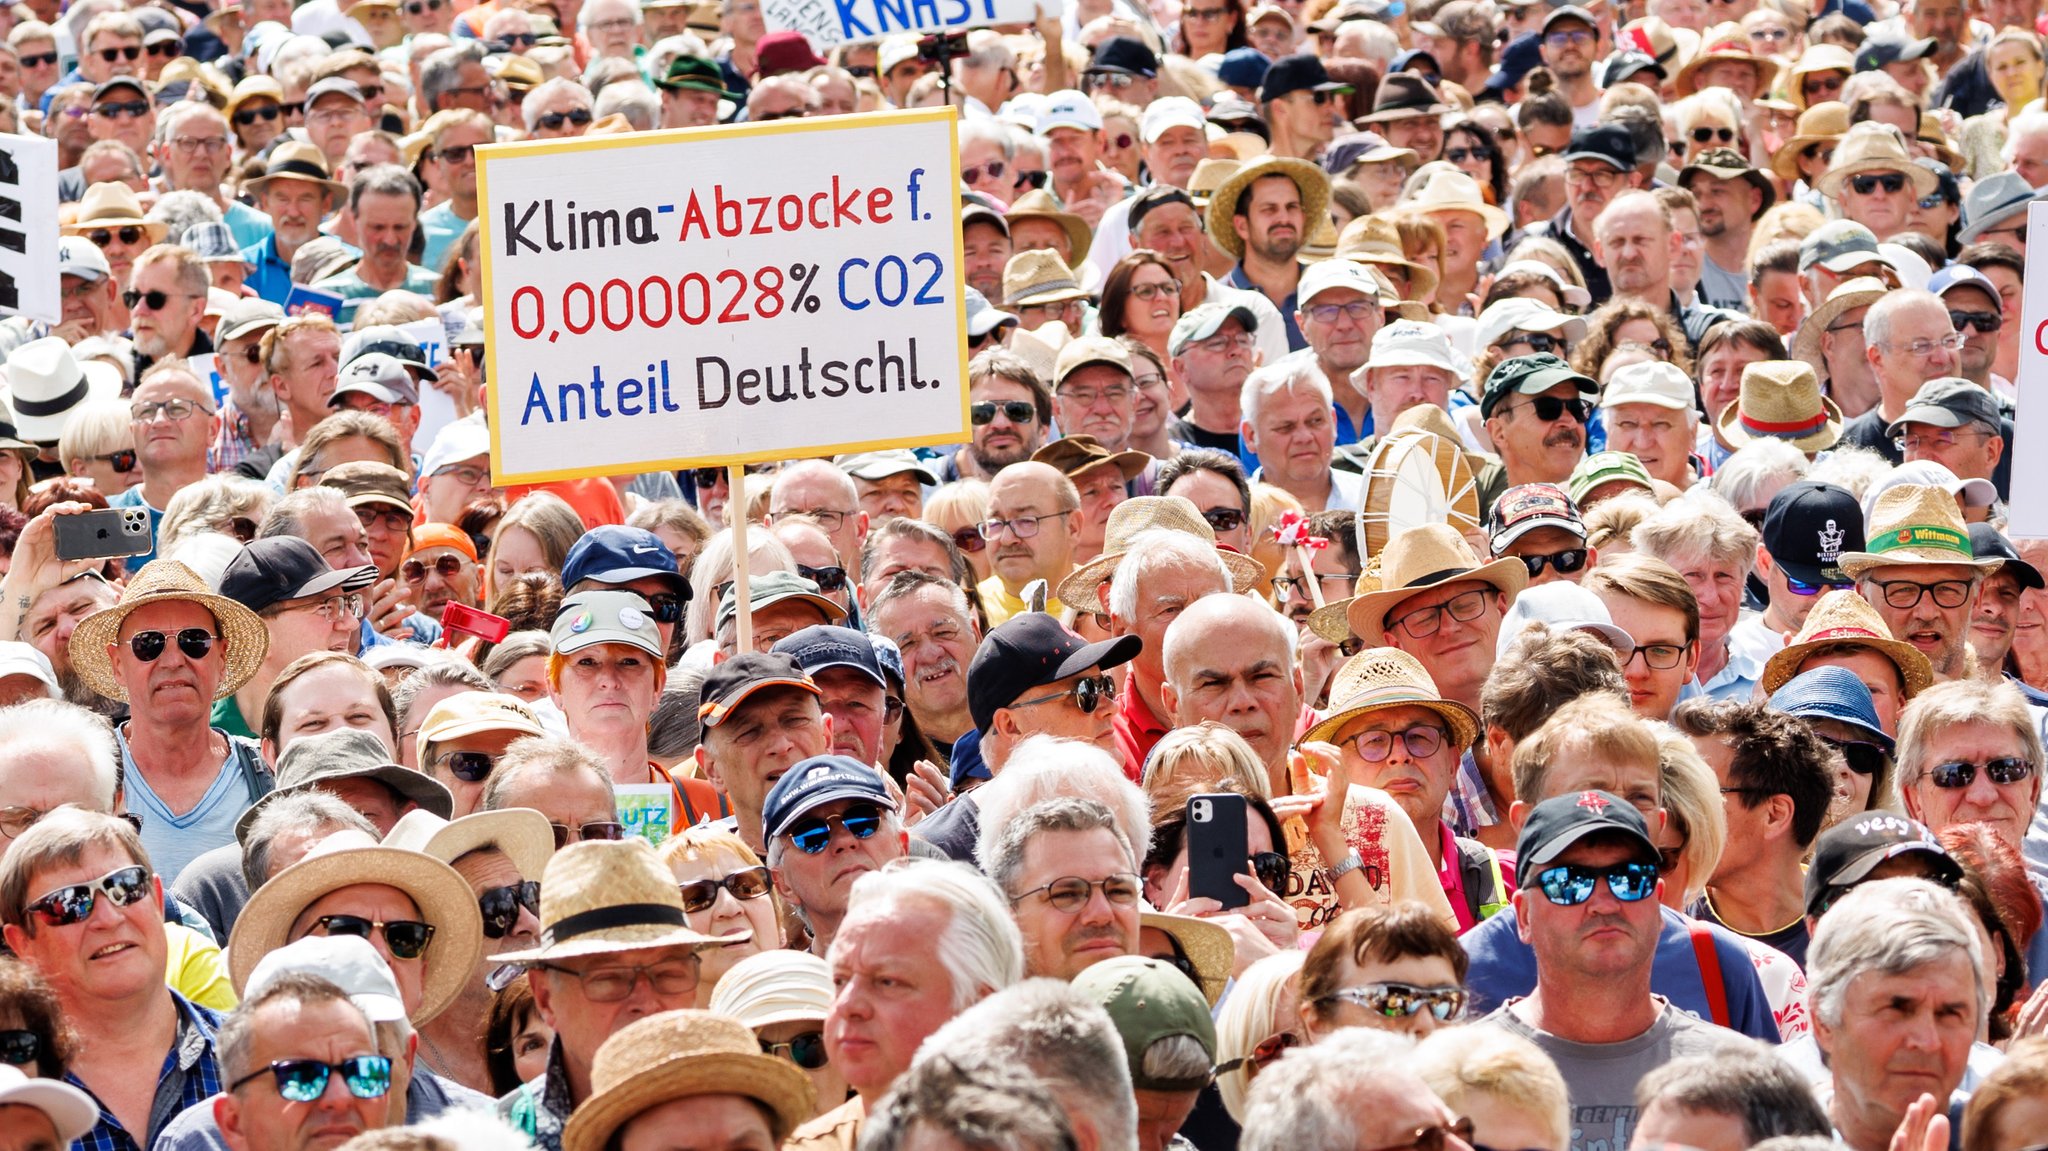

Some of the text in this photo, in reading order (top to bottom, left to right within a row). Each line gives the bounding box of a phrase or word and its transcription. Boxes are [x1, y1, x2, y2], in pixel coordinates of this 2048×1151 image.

[504, 168, 933, 256] Klima-Abzocke f.
[511, 252, 945, 343] 0,000028% CO2
[521, 337, 941, 425] Anteil Deutschl.
[623, 807, 668, 826] UTZ
